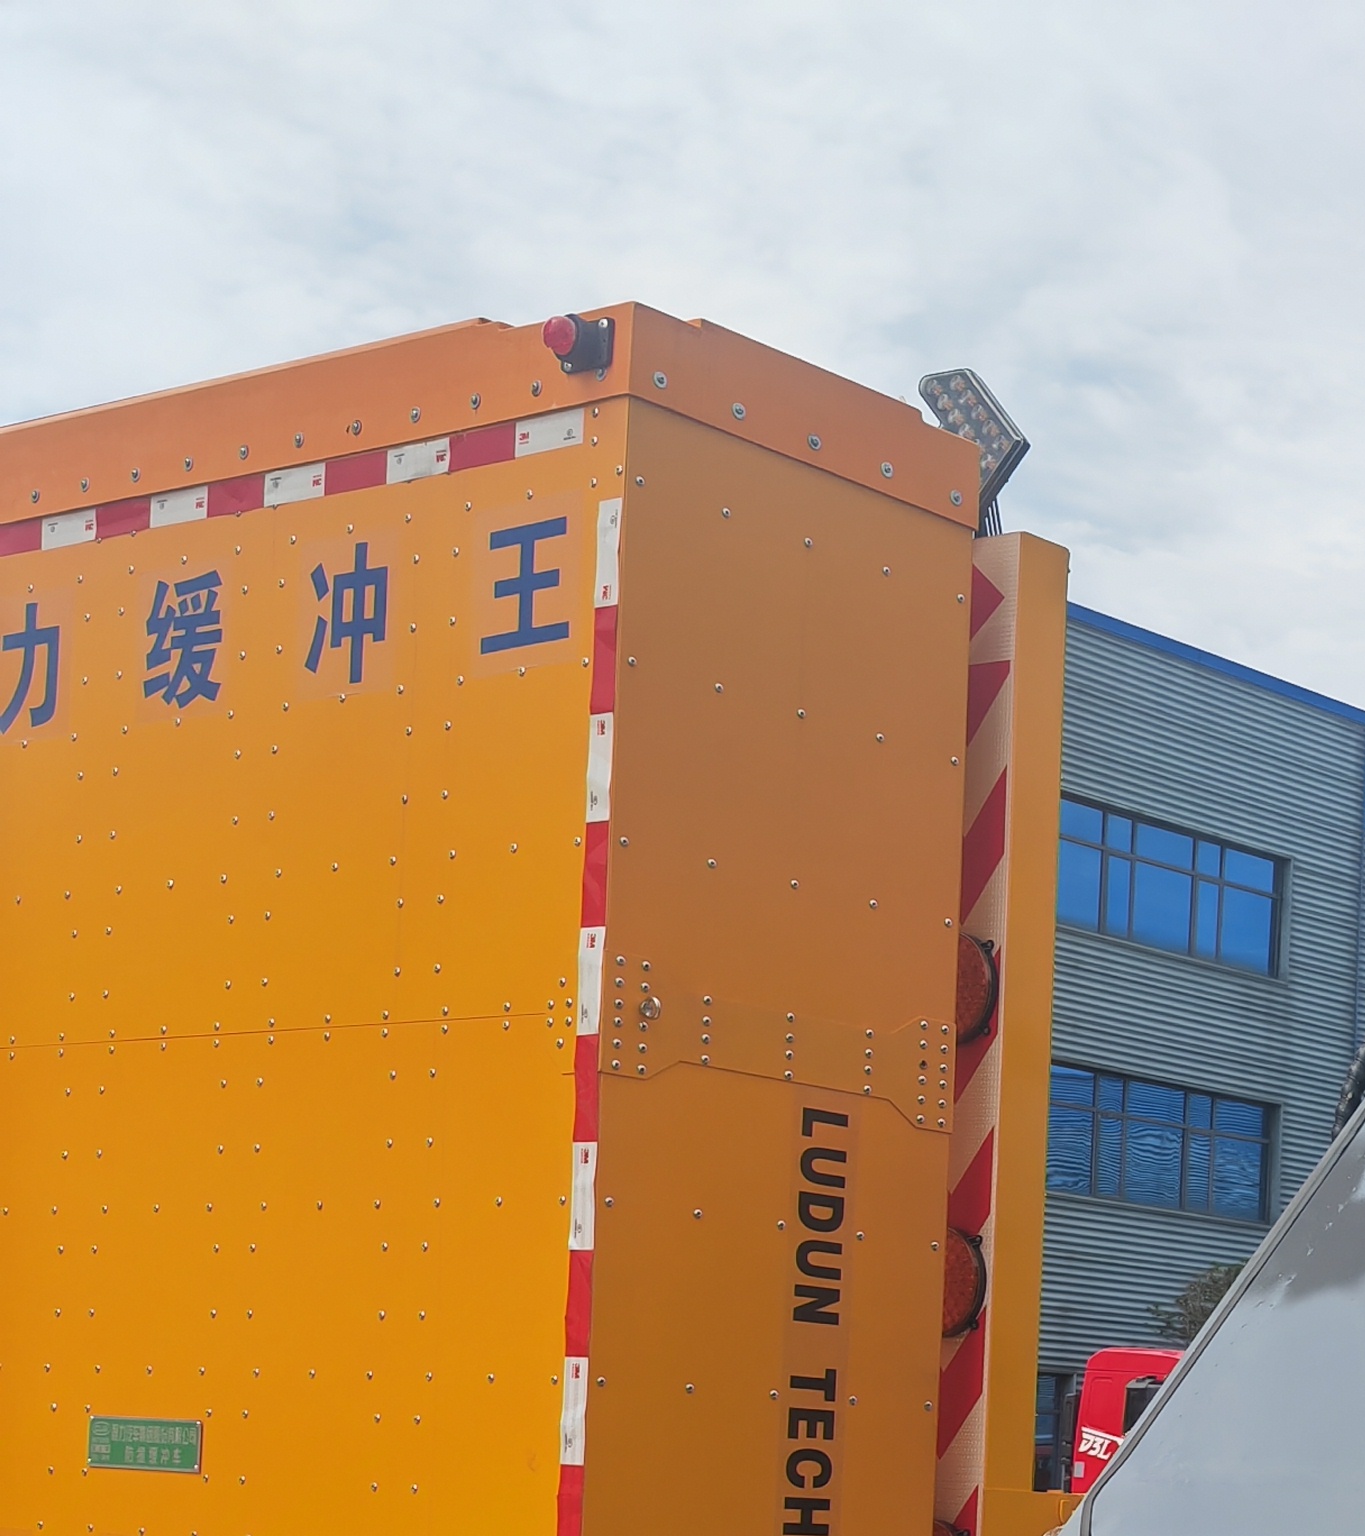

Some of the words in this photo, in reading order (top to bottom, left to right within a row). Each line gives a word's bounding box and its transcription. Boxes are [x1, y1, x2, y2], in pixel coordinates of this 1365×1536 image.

[0, 516, 570, 734] 力缓冲王
[791, 1106, 849, 1326] LUDUN
